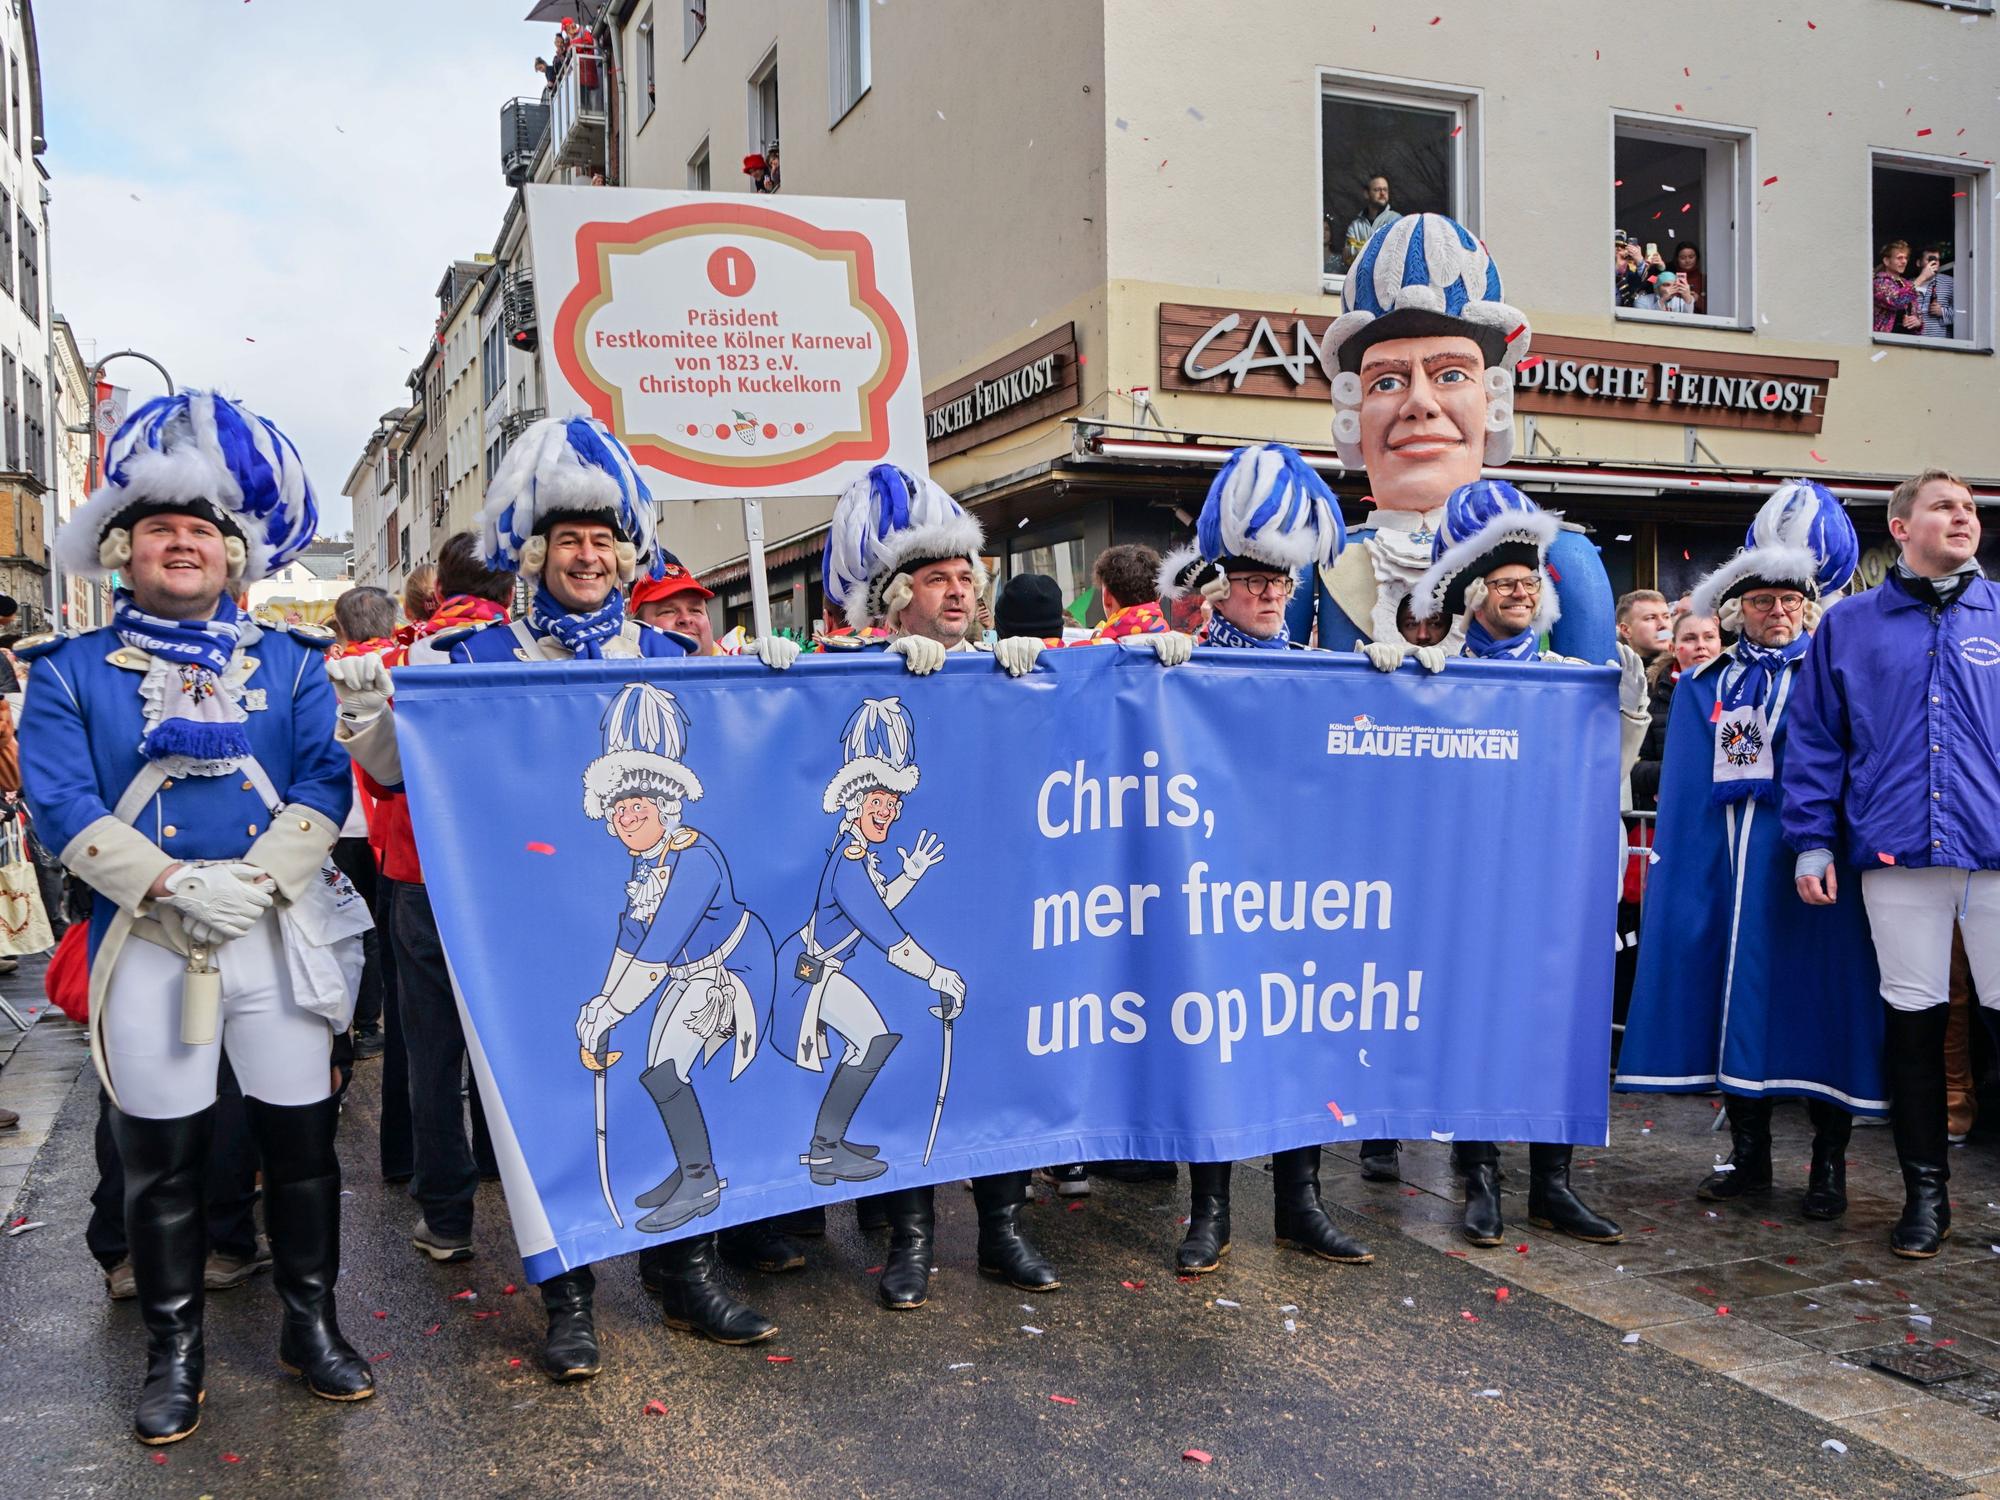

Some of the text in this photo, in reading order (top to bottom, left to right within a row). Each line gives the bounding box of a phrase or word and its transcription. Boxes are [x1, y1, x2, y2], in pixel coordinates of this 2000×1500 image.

[687, 308, 779, 327] Präsident
[595, 329, 872, 350] Festkomitee Kölner Karneval
[675, 354, 799, 371] von 1823 e.V.
[640, 374, 841, 397] Christoph Kuckelkorn
[974, 353, 1055, 421] FEINKOST
[1656, 361, 1819, 414] FEINKOST
[1372, 724, 1401, 733] Funken
[1436, 726, 1454, 735] blau
[1474, 728, 1488, 736] von
[1327, 731, 1519, 760] BLAUE FUNKEN
[1037, 751, 1215, 839] Chris,
[1032, 861, 1392, 950] mer freuen
[1026, 960, 1423, 1063] uns op Dich!
